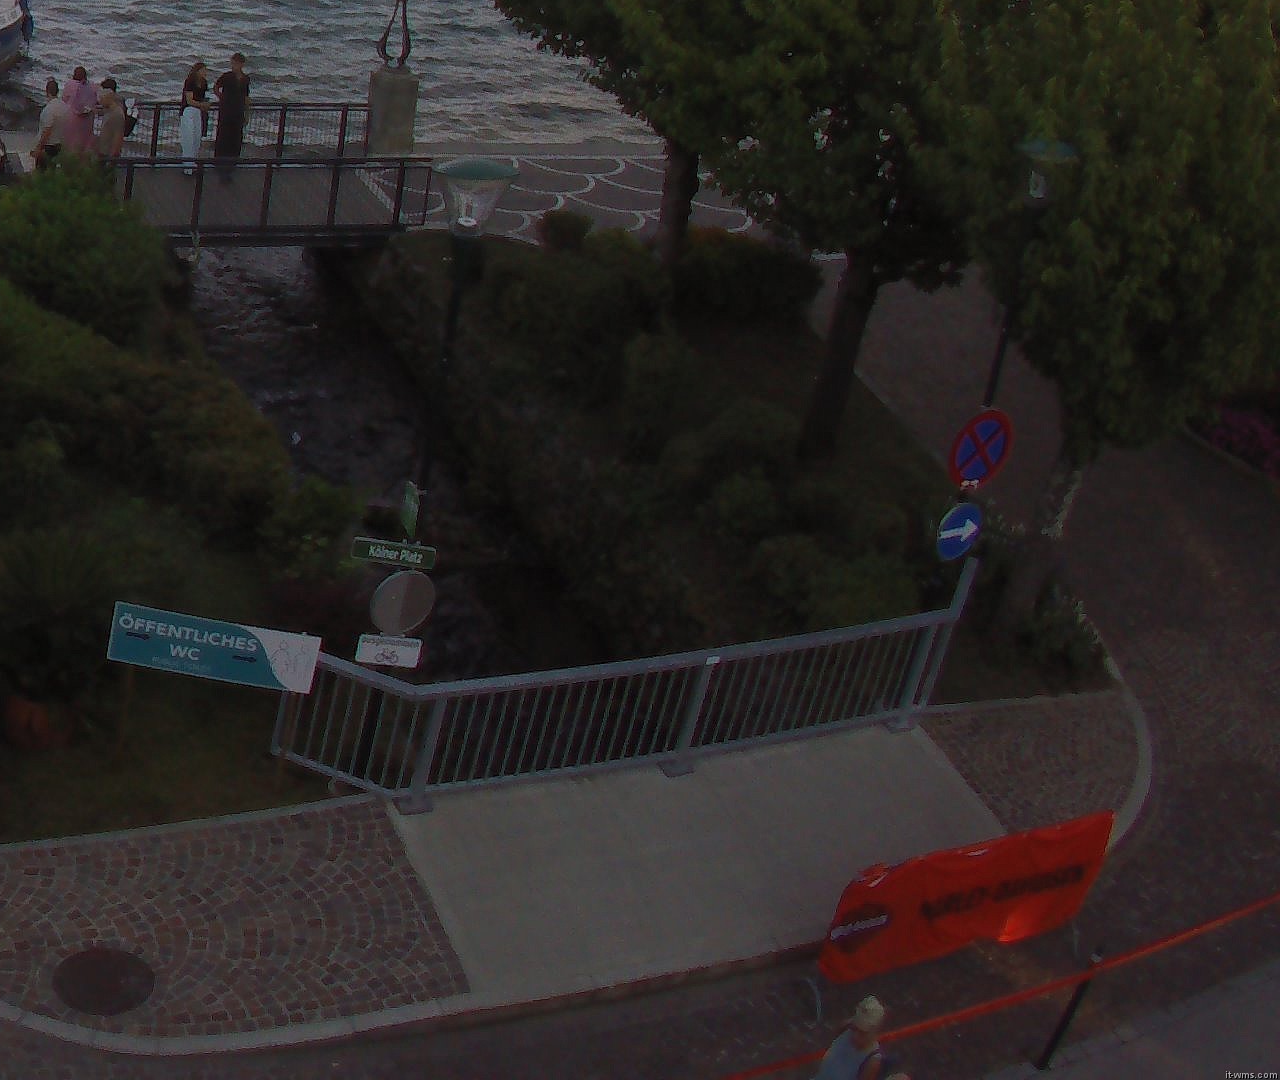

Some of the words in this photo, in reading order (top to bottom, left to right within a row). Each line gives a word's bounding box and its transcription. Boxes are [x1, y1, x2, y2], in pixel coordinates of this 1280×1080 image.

[368, 544, 399, 561] Kölner
[399, 547, 424, 565] Platz
[118, 612, 258, 653] ÖFFENTLICHES
[169, 643, 201, 662] WC
